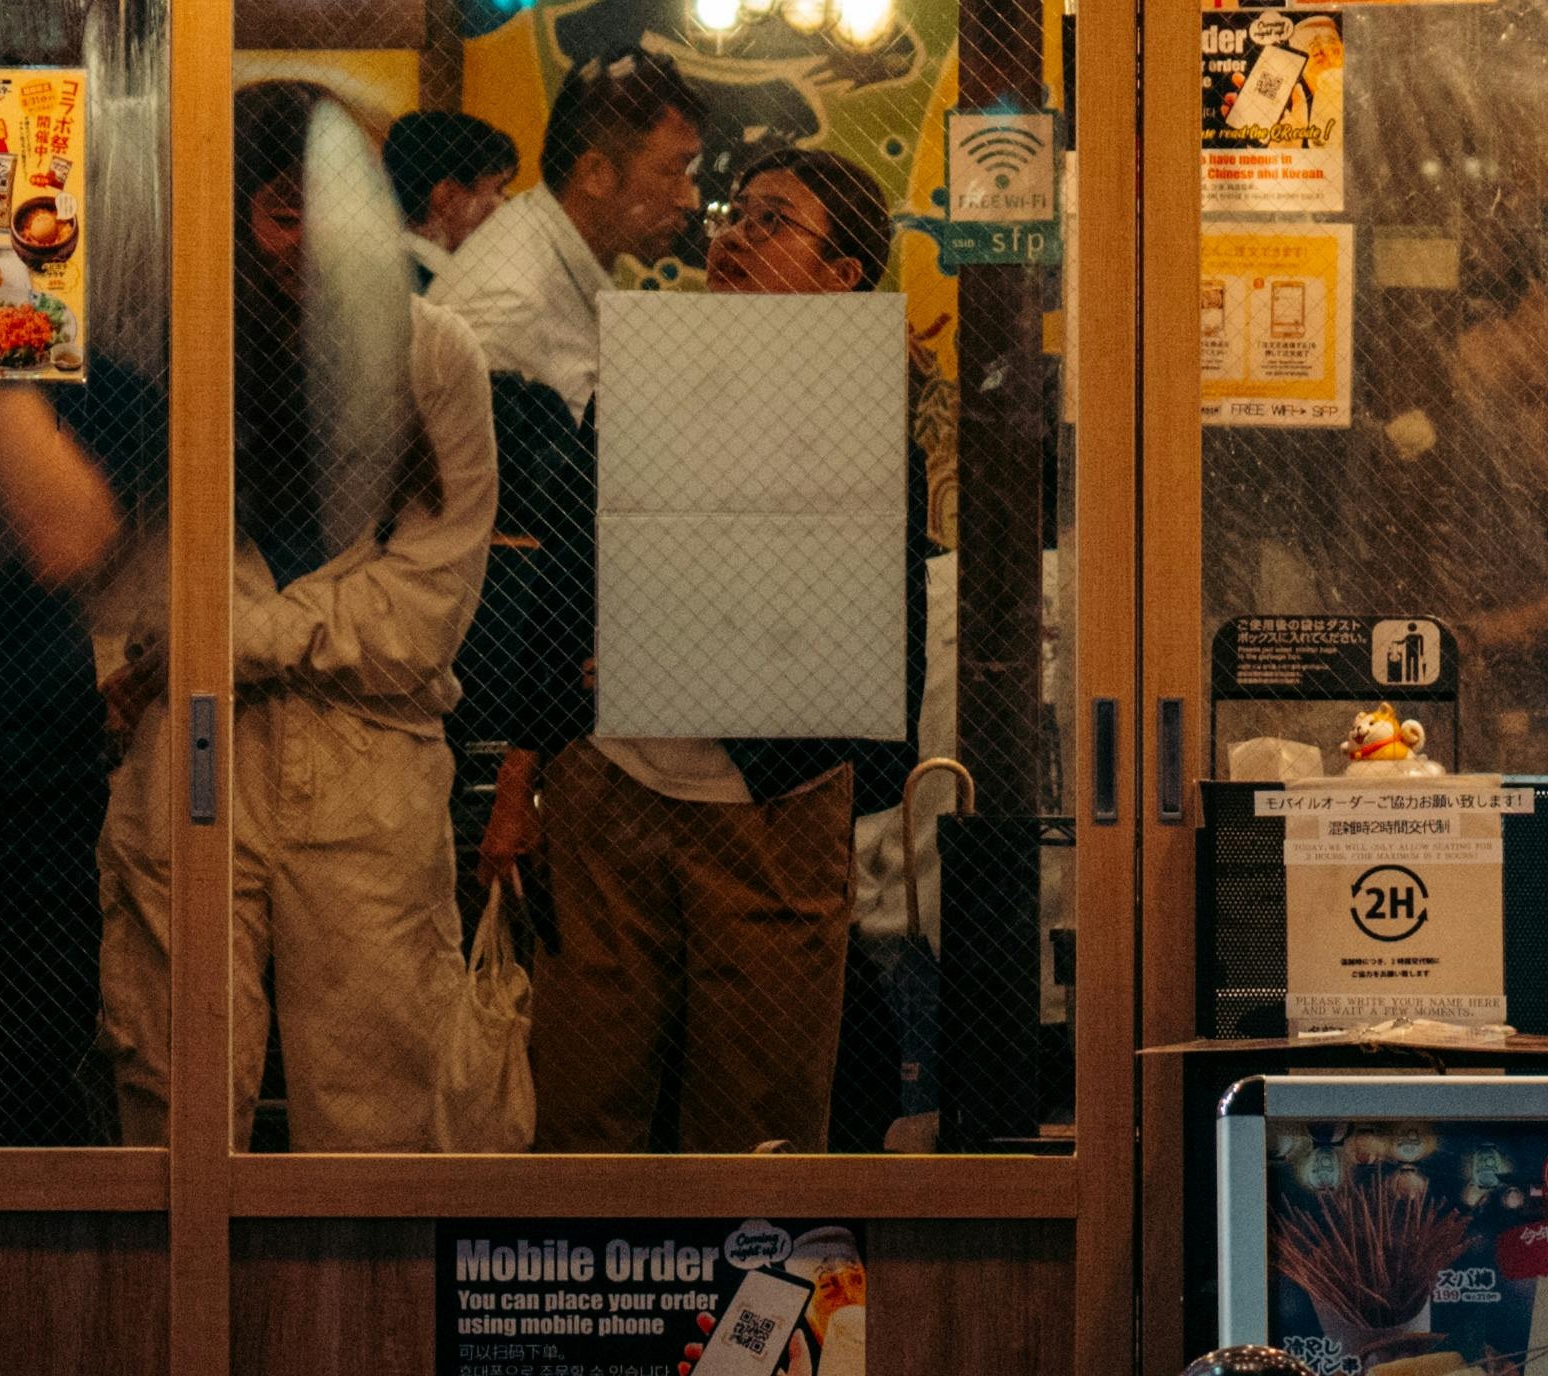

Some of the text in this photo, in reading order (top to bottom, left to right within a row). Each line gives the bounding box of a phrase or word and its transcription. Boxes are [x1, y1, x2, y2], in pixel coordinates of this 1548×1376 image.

[1366, 887, 1414, 919] 2H
[455, 1238, 720, 1283] Mobile Order
[458, 1289, 719, 1315] You can place your order
[458, 1315, 665, 1337] using mobile phone
